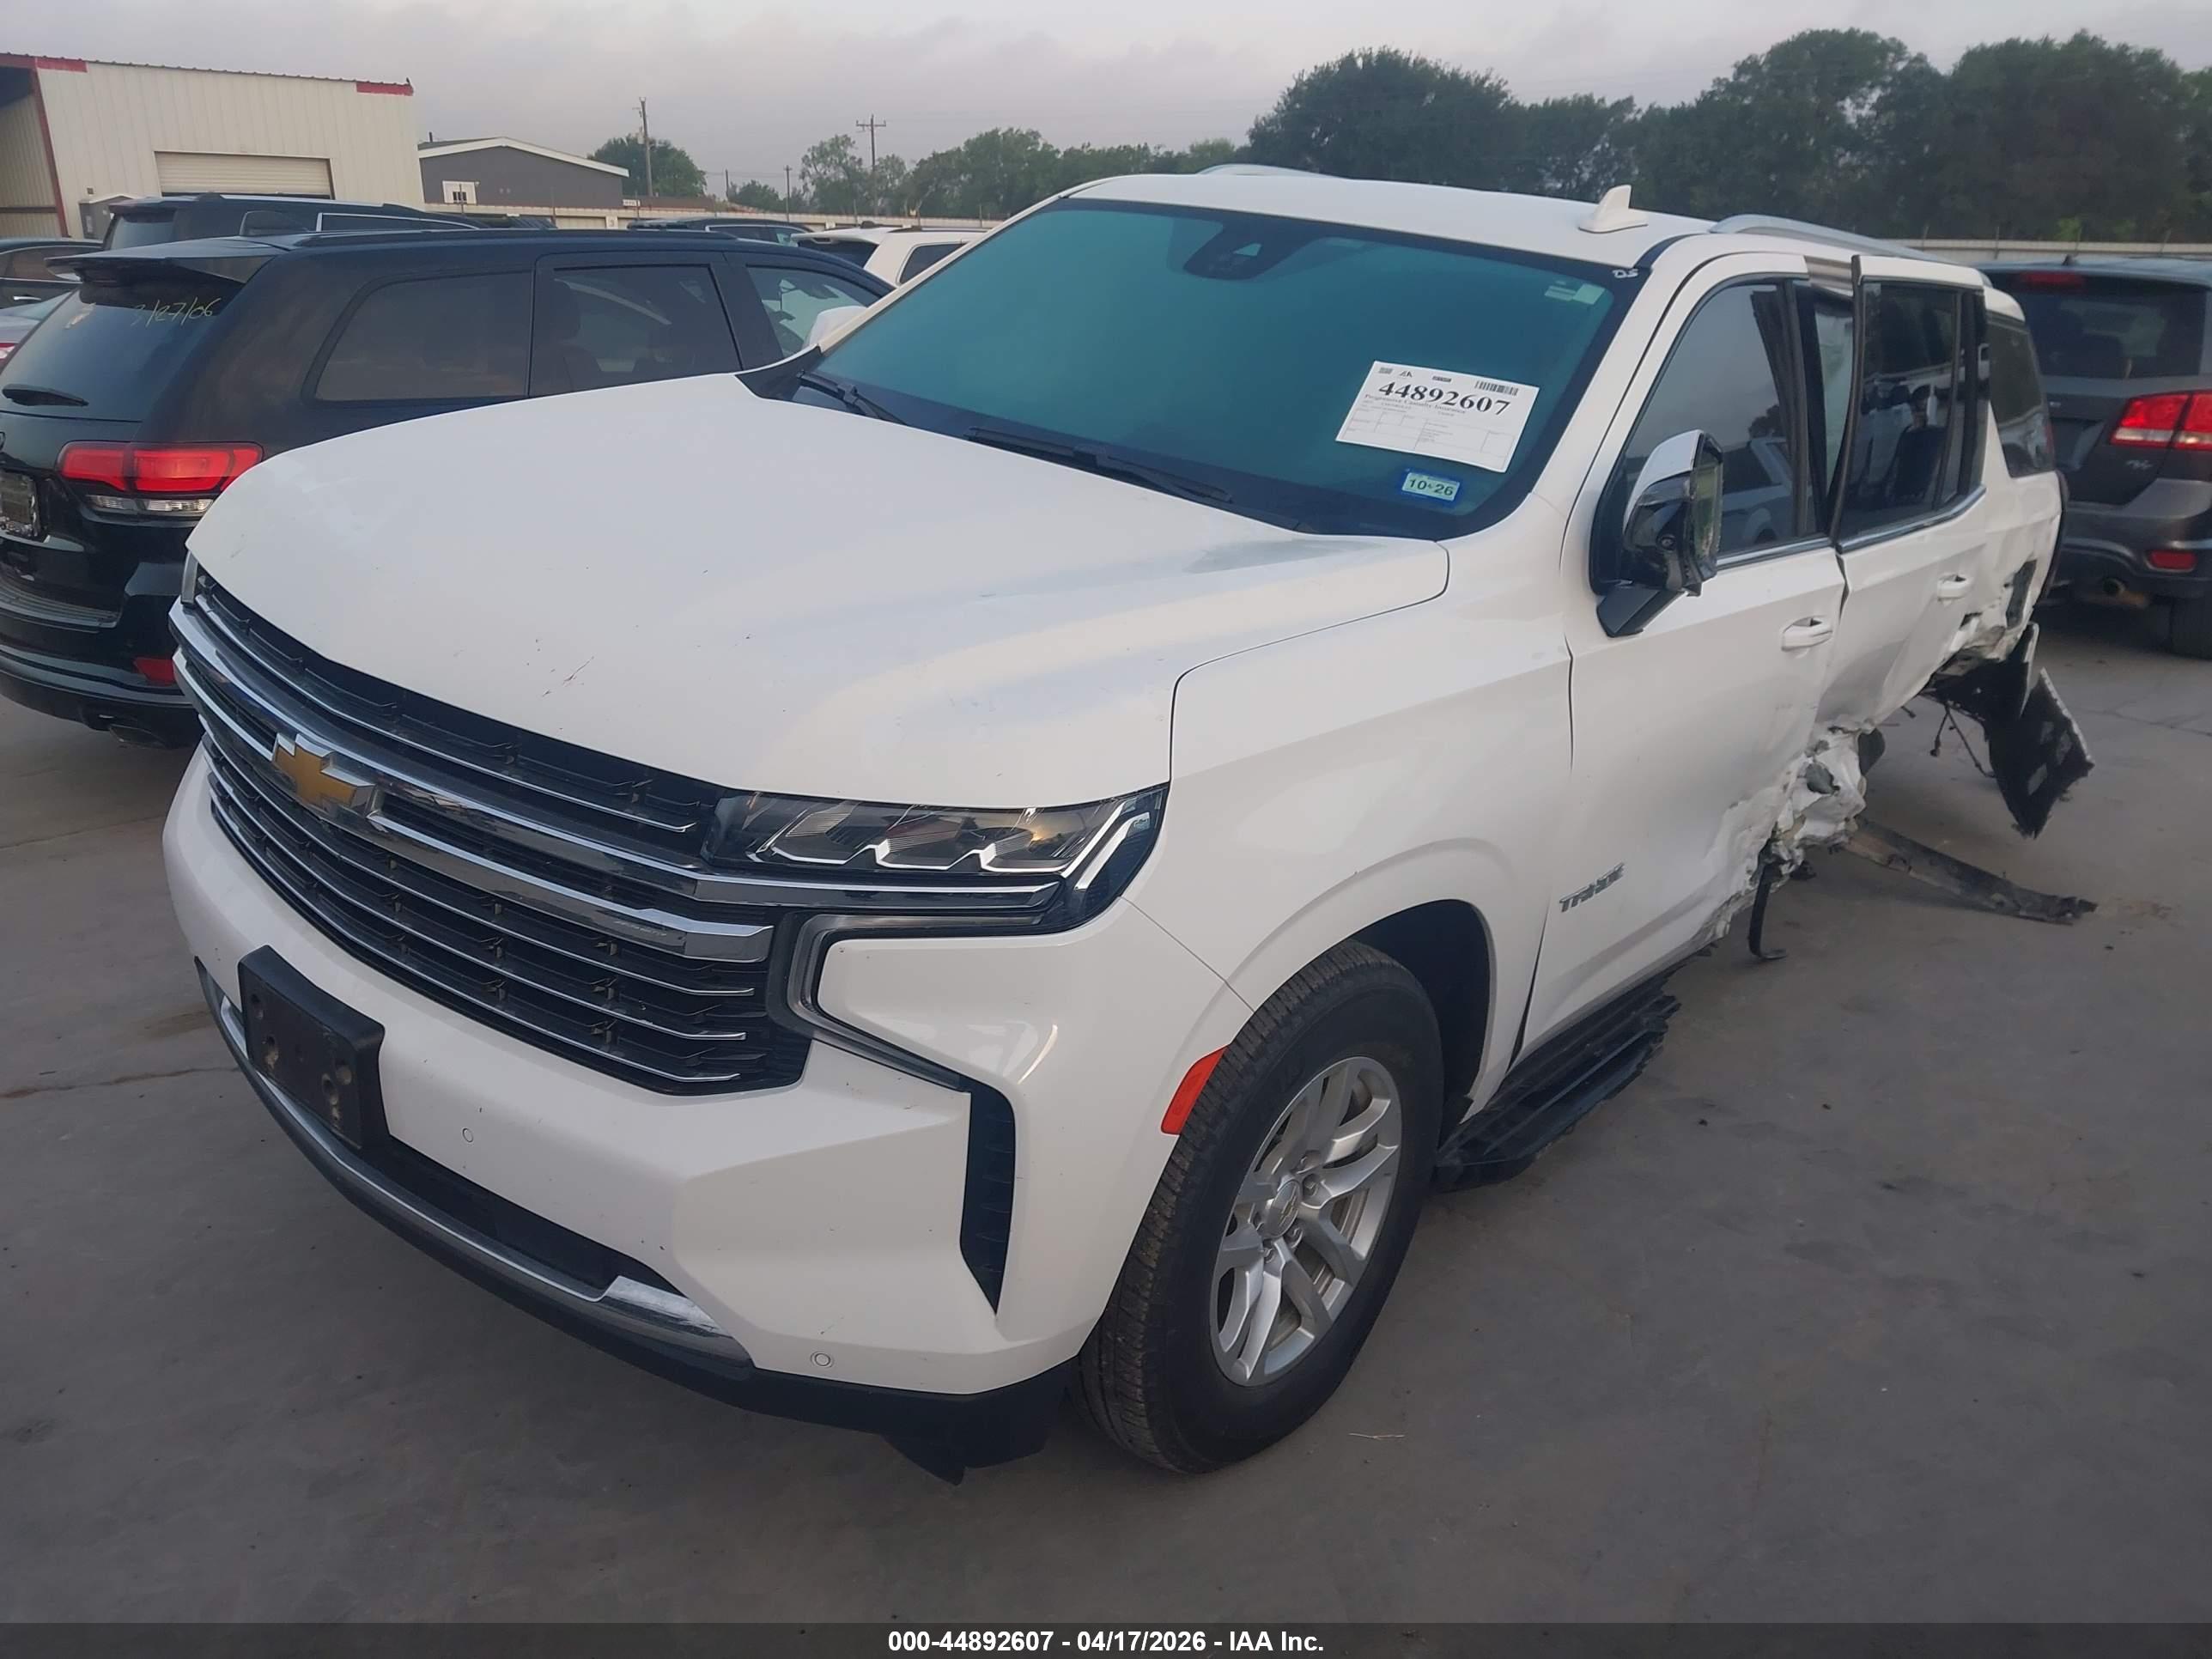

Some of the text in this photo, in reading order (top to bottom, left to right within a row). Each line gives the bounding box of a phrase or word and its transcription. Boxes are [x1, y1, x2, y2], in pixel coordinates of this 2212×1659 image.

[1378, 380, 1511, 416] 44892607
[1409, 478, 1454, 496] 10 26
